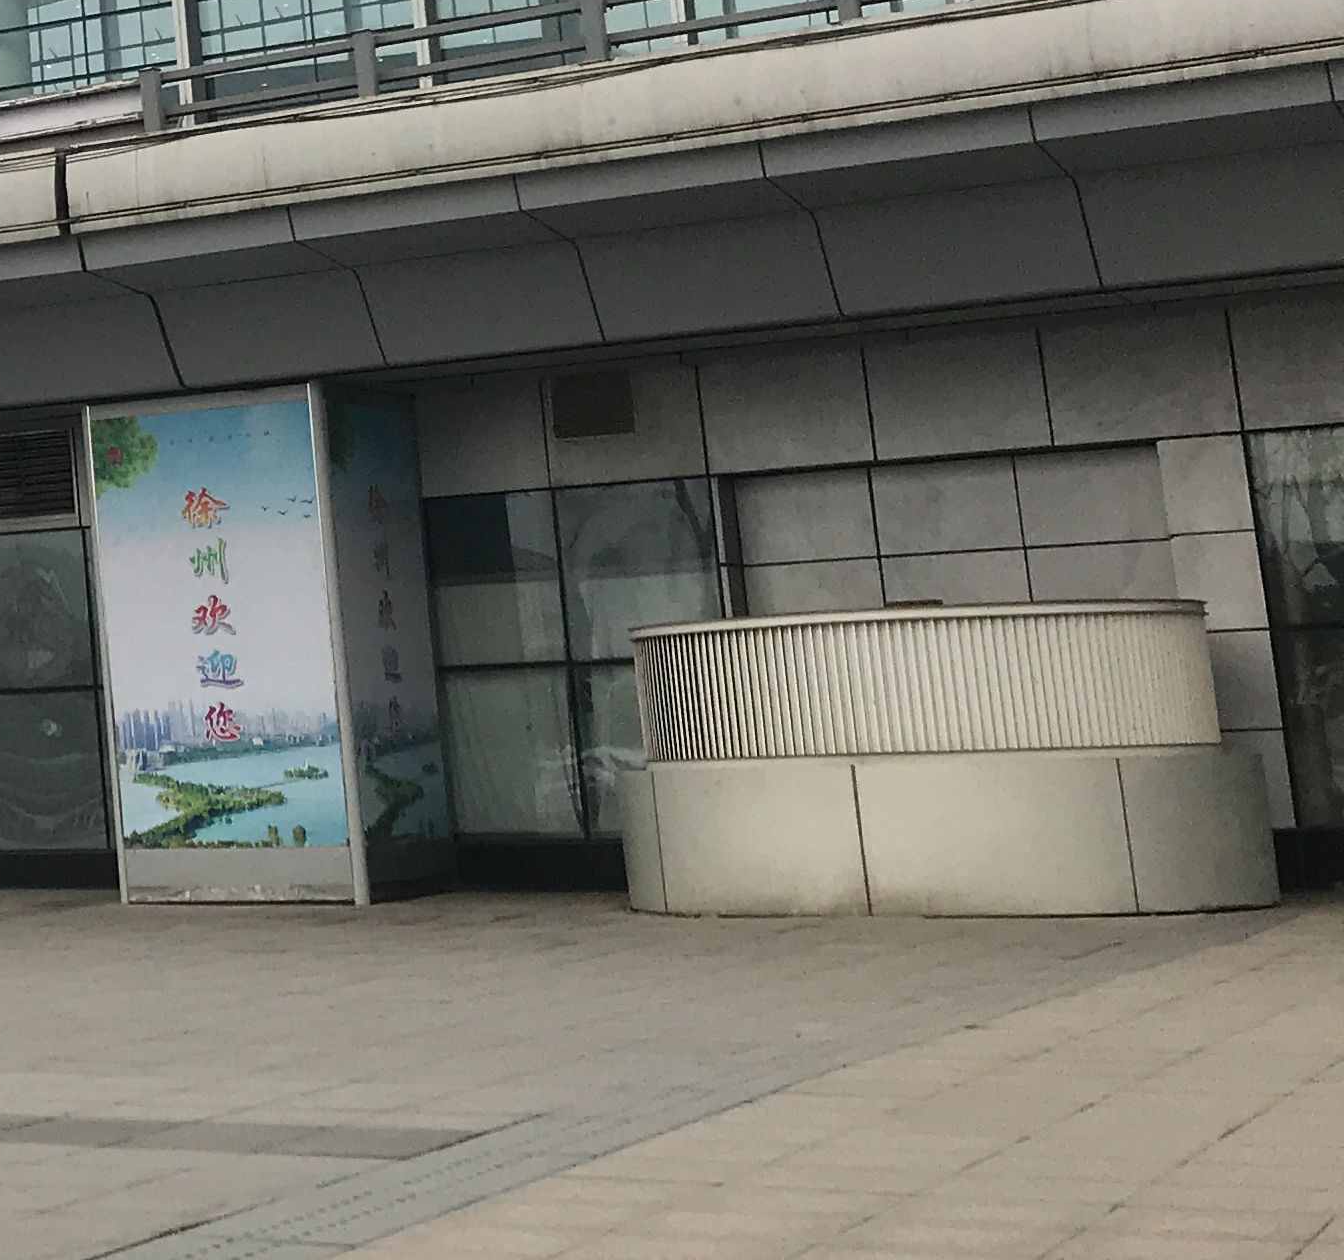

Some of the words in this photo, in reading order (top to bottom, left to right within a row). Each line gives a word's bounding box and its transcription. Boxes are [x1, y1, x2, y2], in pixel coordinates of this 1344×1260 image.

[181, 486, 245, 743] 徐州欢迎您
